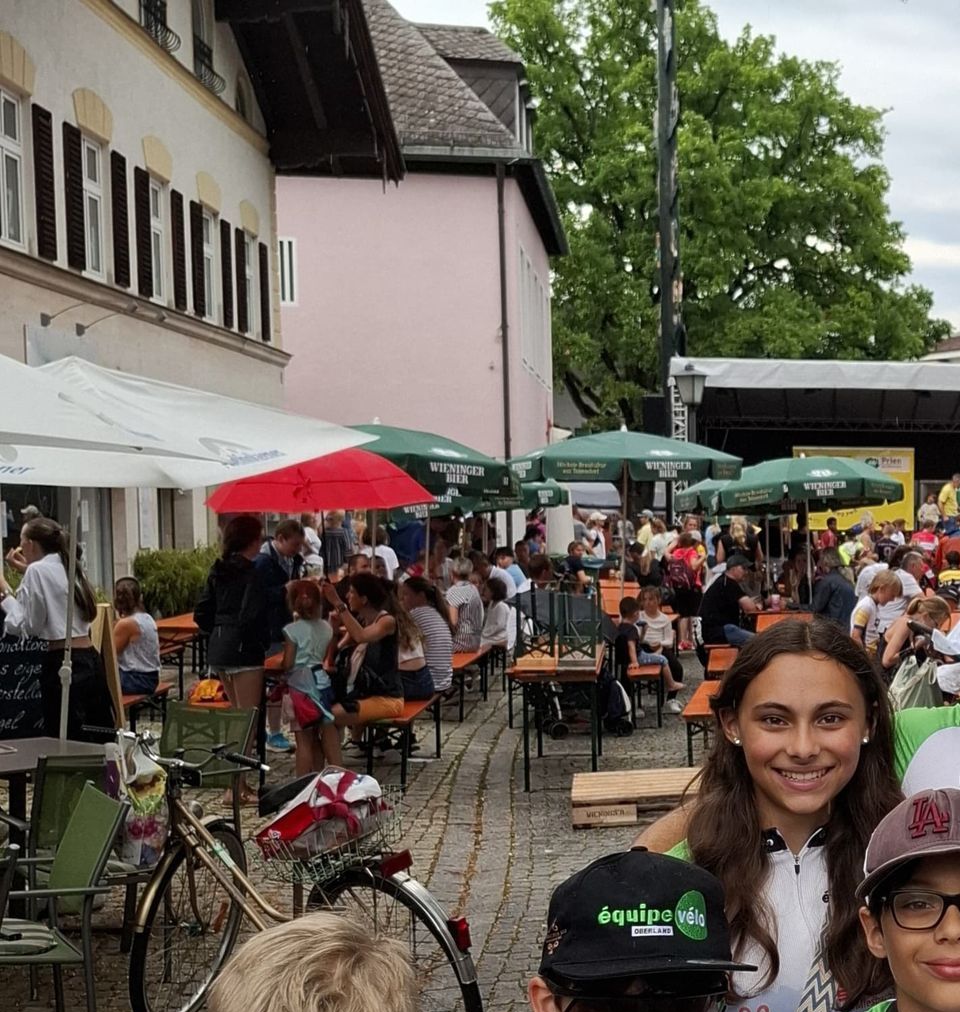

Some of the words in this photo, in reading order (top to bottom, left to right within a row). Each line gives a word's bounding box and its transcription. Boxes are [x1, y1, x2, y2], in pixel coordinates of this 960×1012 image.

[430, 461, 485, 477] WIENINGER
[645, 461, 692, 471] WIENINGER
[446, 473, 469, 485] BIER
[659, 470, 678, 478] BIER
[803, 481, 847, 491] WIENINGER
[908, 797, 950, 839] LA
[598, 903, 673, 926] équipe
[677, 907, 706, 927] vélo
[634, 927, 672, 935] OBERLAND
